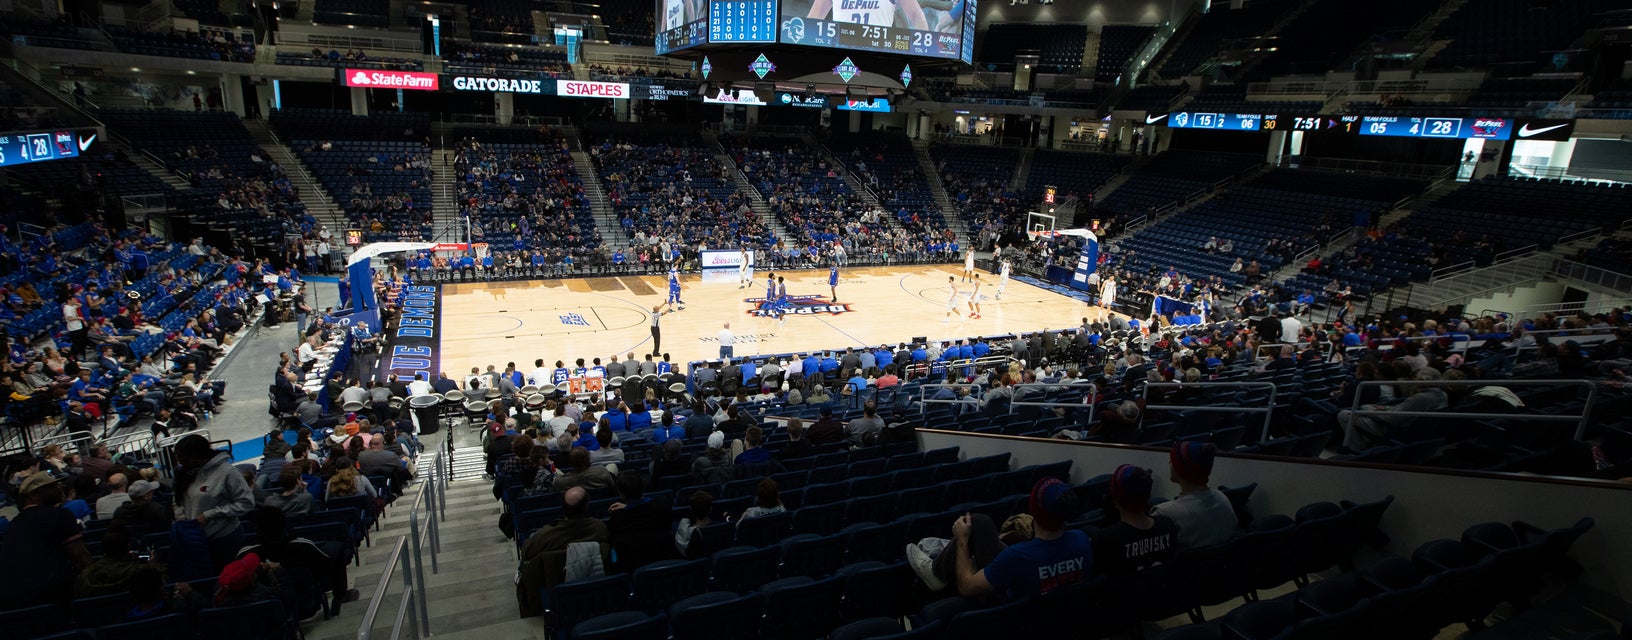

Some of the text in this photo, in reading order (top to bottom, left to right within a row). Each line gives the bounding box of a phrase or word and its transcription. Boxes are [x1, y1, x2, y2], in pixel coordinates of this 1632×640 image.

[817, 22, 836, 37] 15
[862, 25, 888, 39] 7:51
[913, 31, 933, 47] 28
[453, 76, 541, 93] GATORADE
[566, 82, 622, 97] STAPLES
[1199, 115, 1321, 130] 15 2 06 30 7:51
[1345, 121, 1452, 135] 1 05 4 28
[20, 143, 28, 160] 4
[33, 138, 48, 157] 28
[1046, 194, 1054, 203] 30
[349, 236, 359, 244] 30
[396, 285, 436, 338] DEMONS
[1124, 532, 1170, 559] TRUBISKY
[1038, 555, 1084, 580] EVERY
